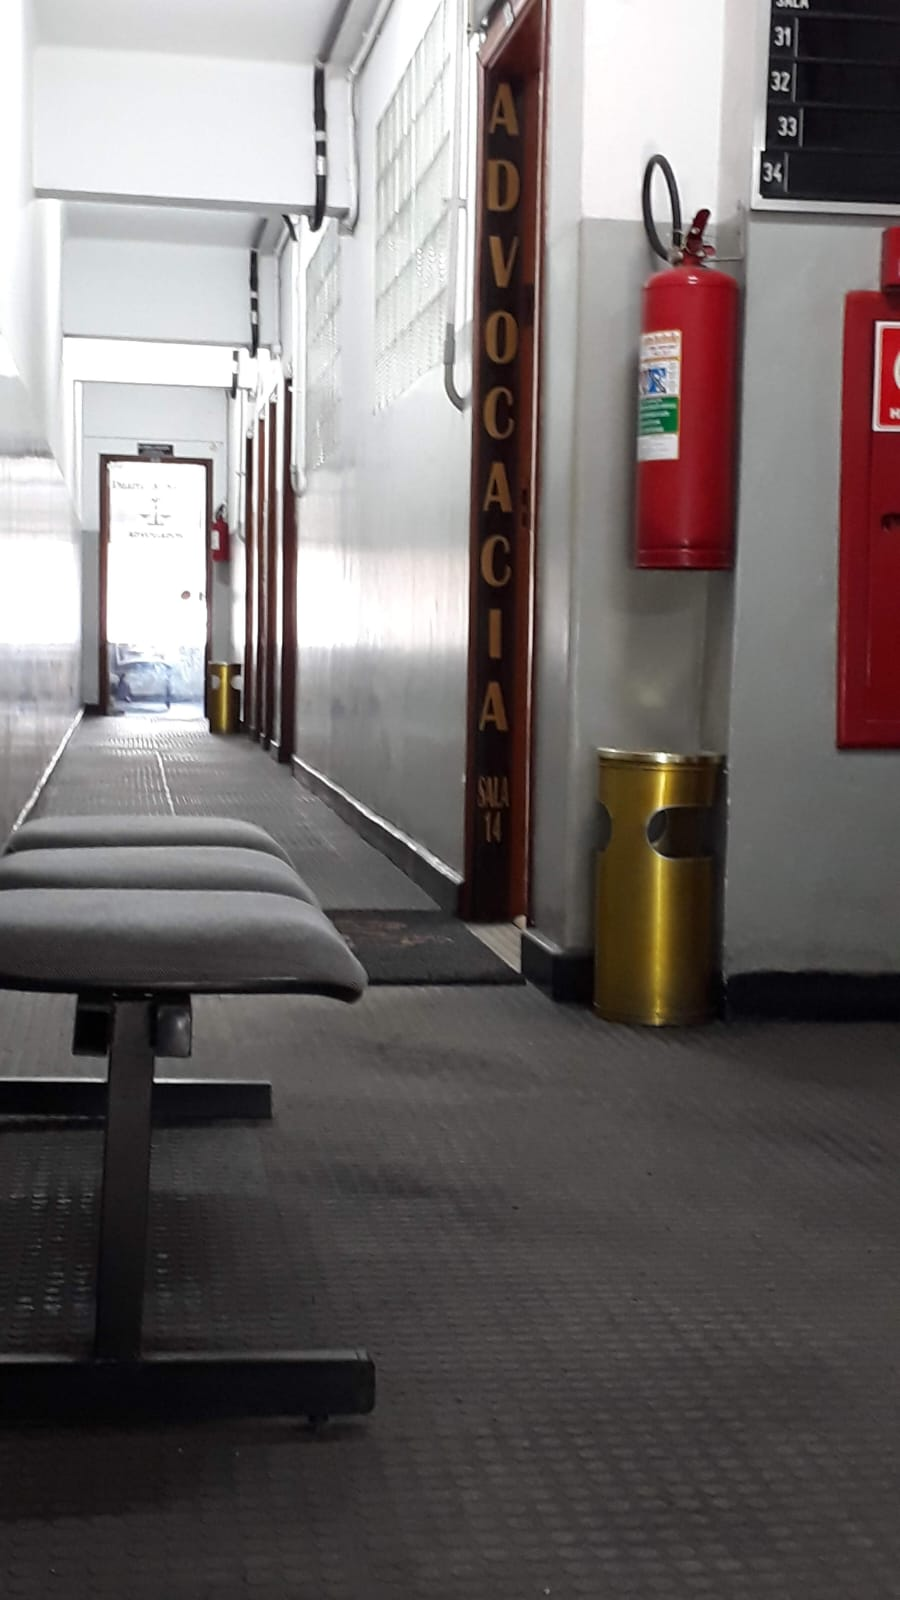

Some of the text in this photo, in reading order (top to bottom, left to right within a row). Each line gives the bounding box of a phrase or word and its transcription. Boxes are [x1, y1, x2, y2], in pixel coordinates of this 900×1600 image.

[774, 26, 792, 47] 31
[771, 71, 791, 92] 32
[777, 116, 798, 137] 33
[762, 162, 783, 183] 34
[479, 82, 521, 732] ADVOCACIA
[478, 775, 510, 808] SALA
[485, 810, 502, 843] 14
